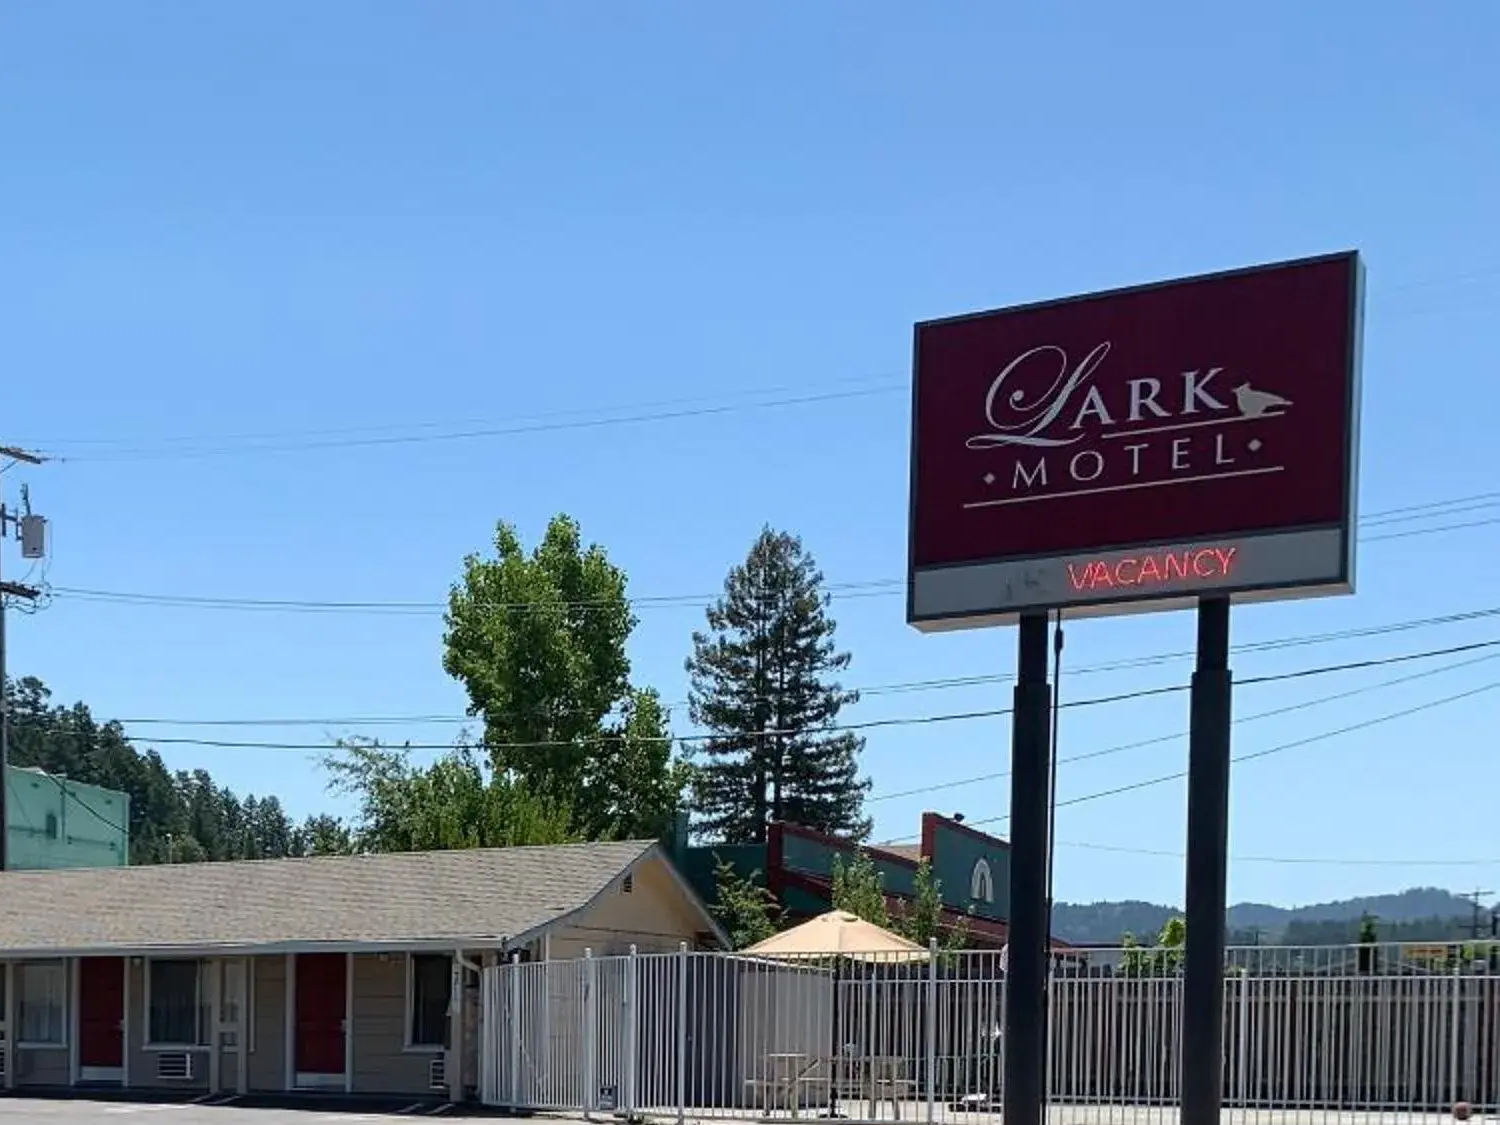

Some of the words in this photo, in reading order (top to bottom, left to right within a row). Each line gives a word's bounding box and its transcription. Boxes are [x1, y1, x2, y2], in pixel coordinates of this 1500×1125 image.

[965, 341, 1230, 447] LARK
[1011, 434, 1235, 489] MOTEL
[1066, 547, 1237, 590] VACANCY
